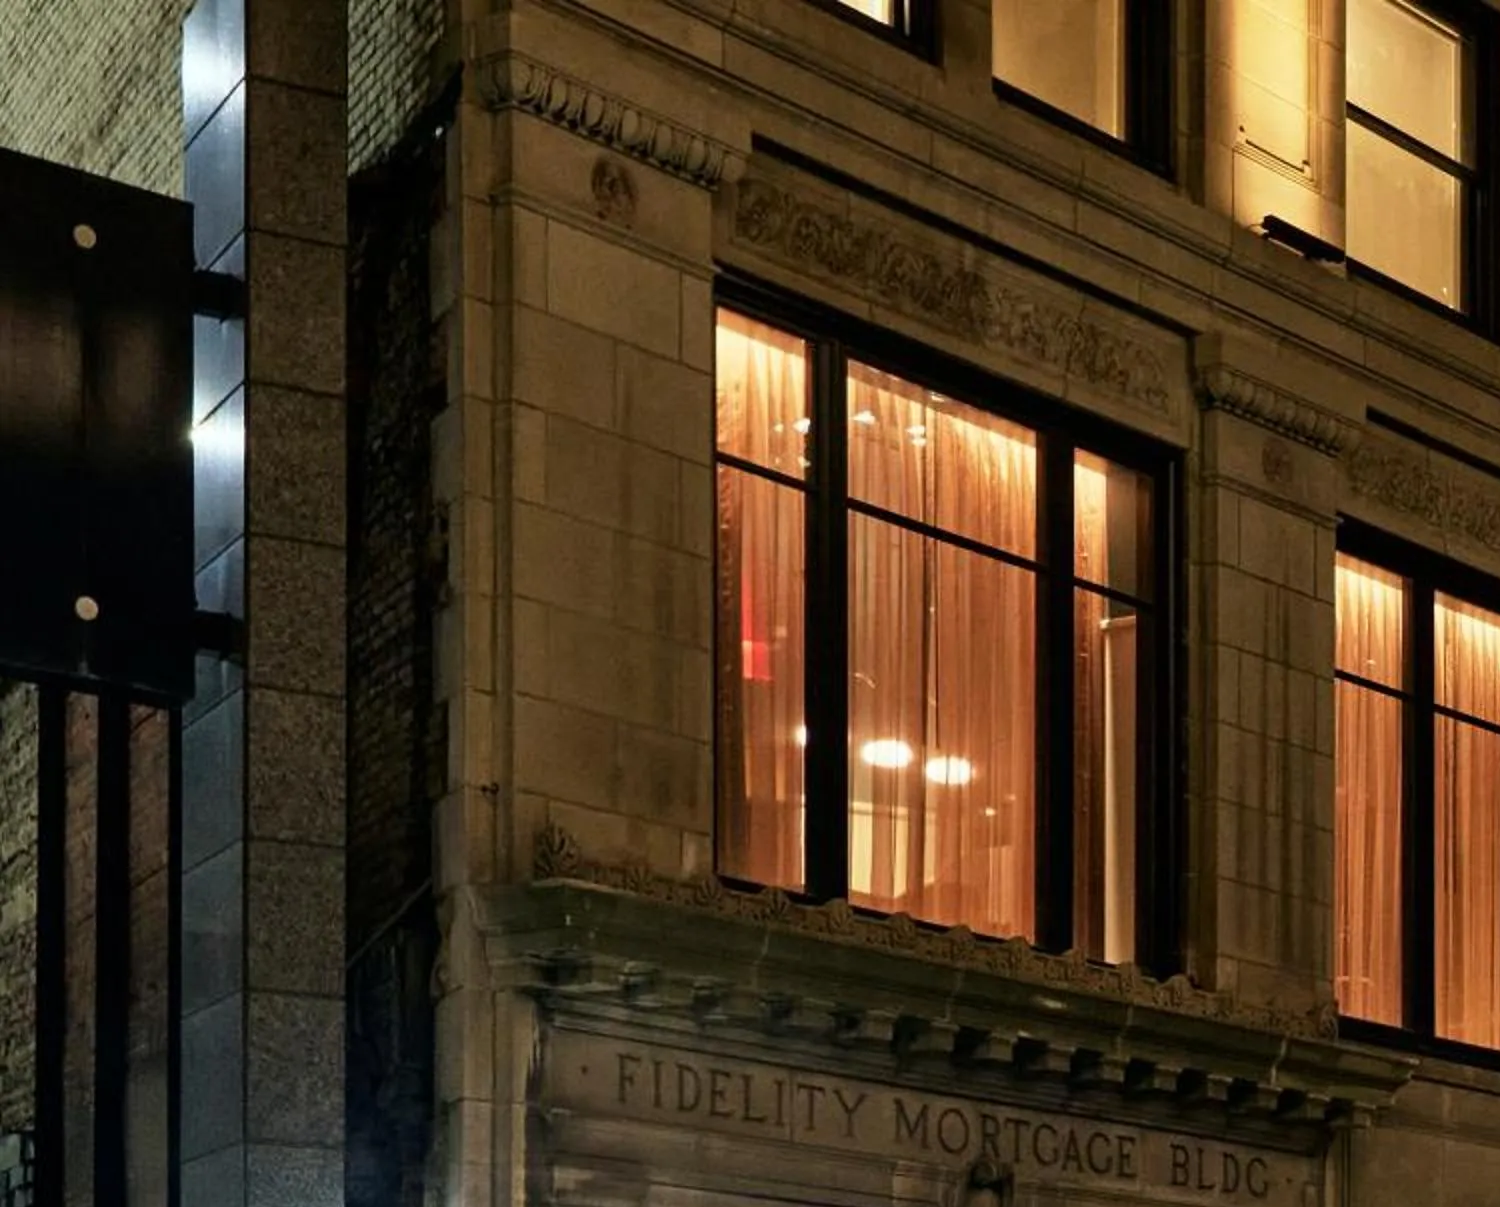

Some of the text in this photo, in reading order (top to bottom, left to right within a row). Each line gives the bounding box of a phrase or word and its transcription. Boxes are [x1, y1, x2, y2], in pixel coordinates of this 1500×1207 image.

[616, 1053, 1269, 1199] FIDELITY MORTGAGE BLDG
